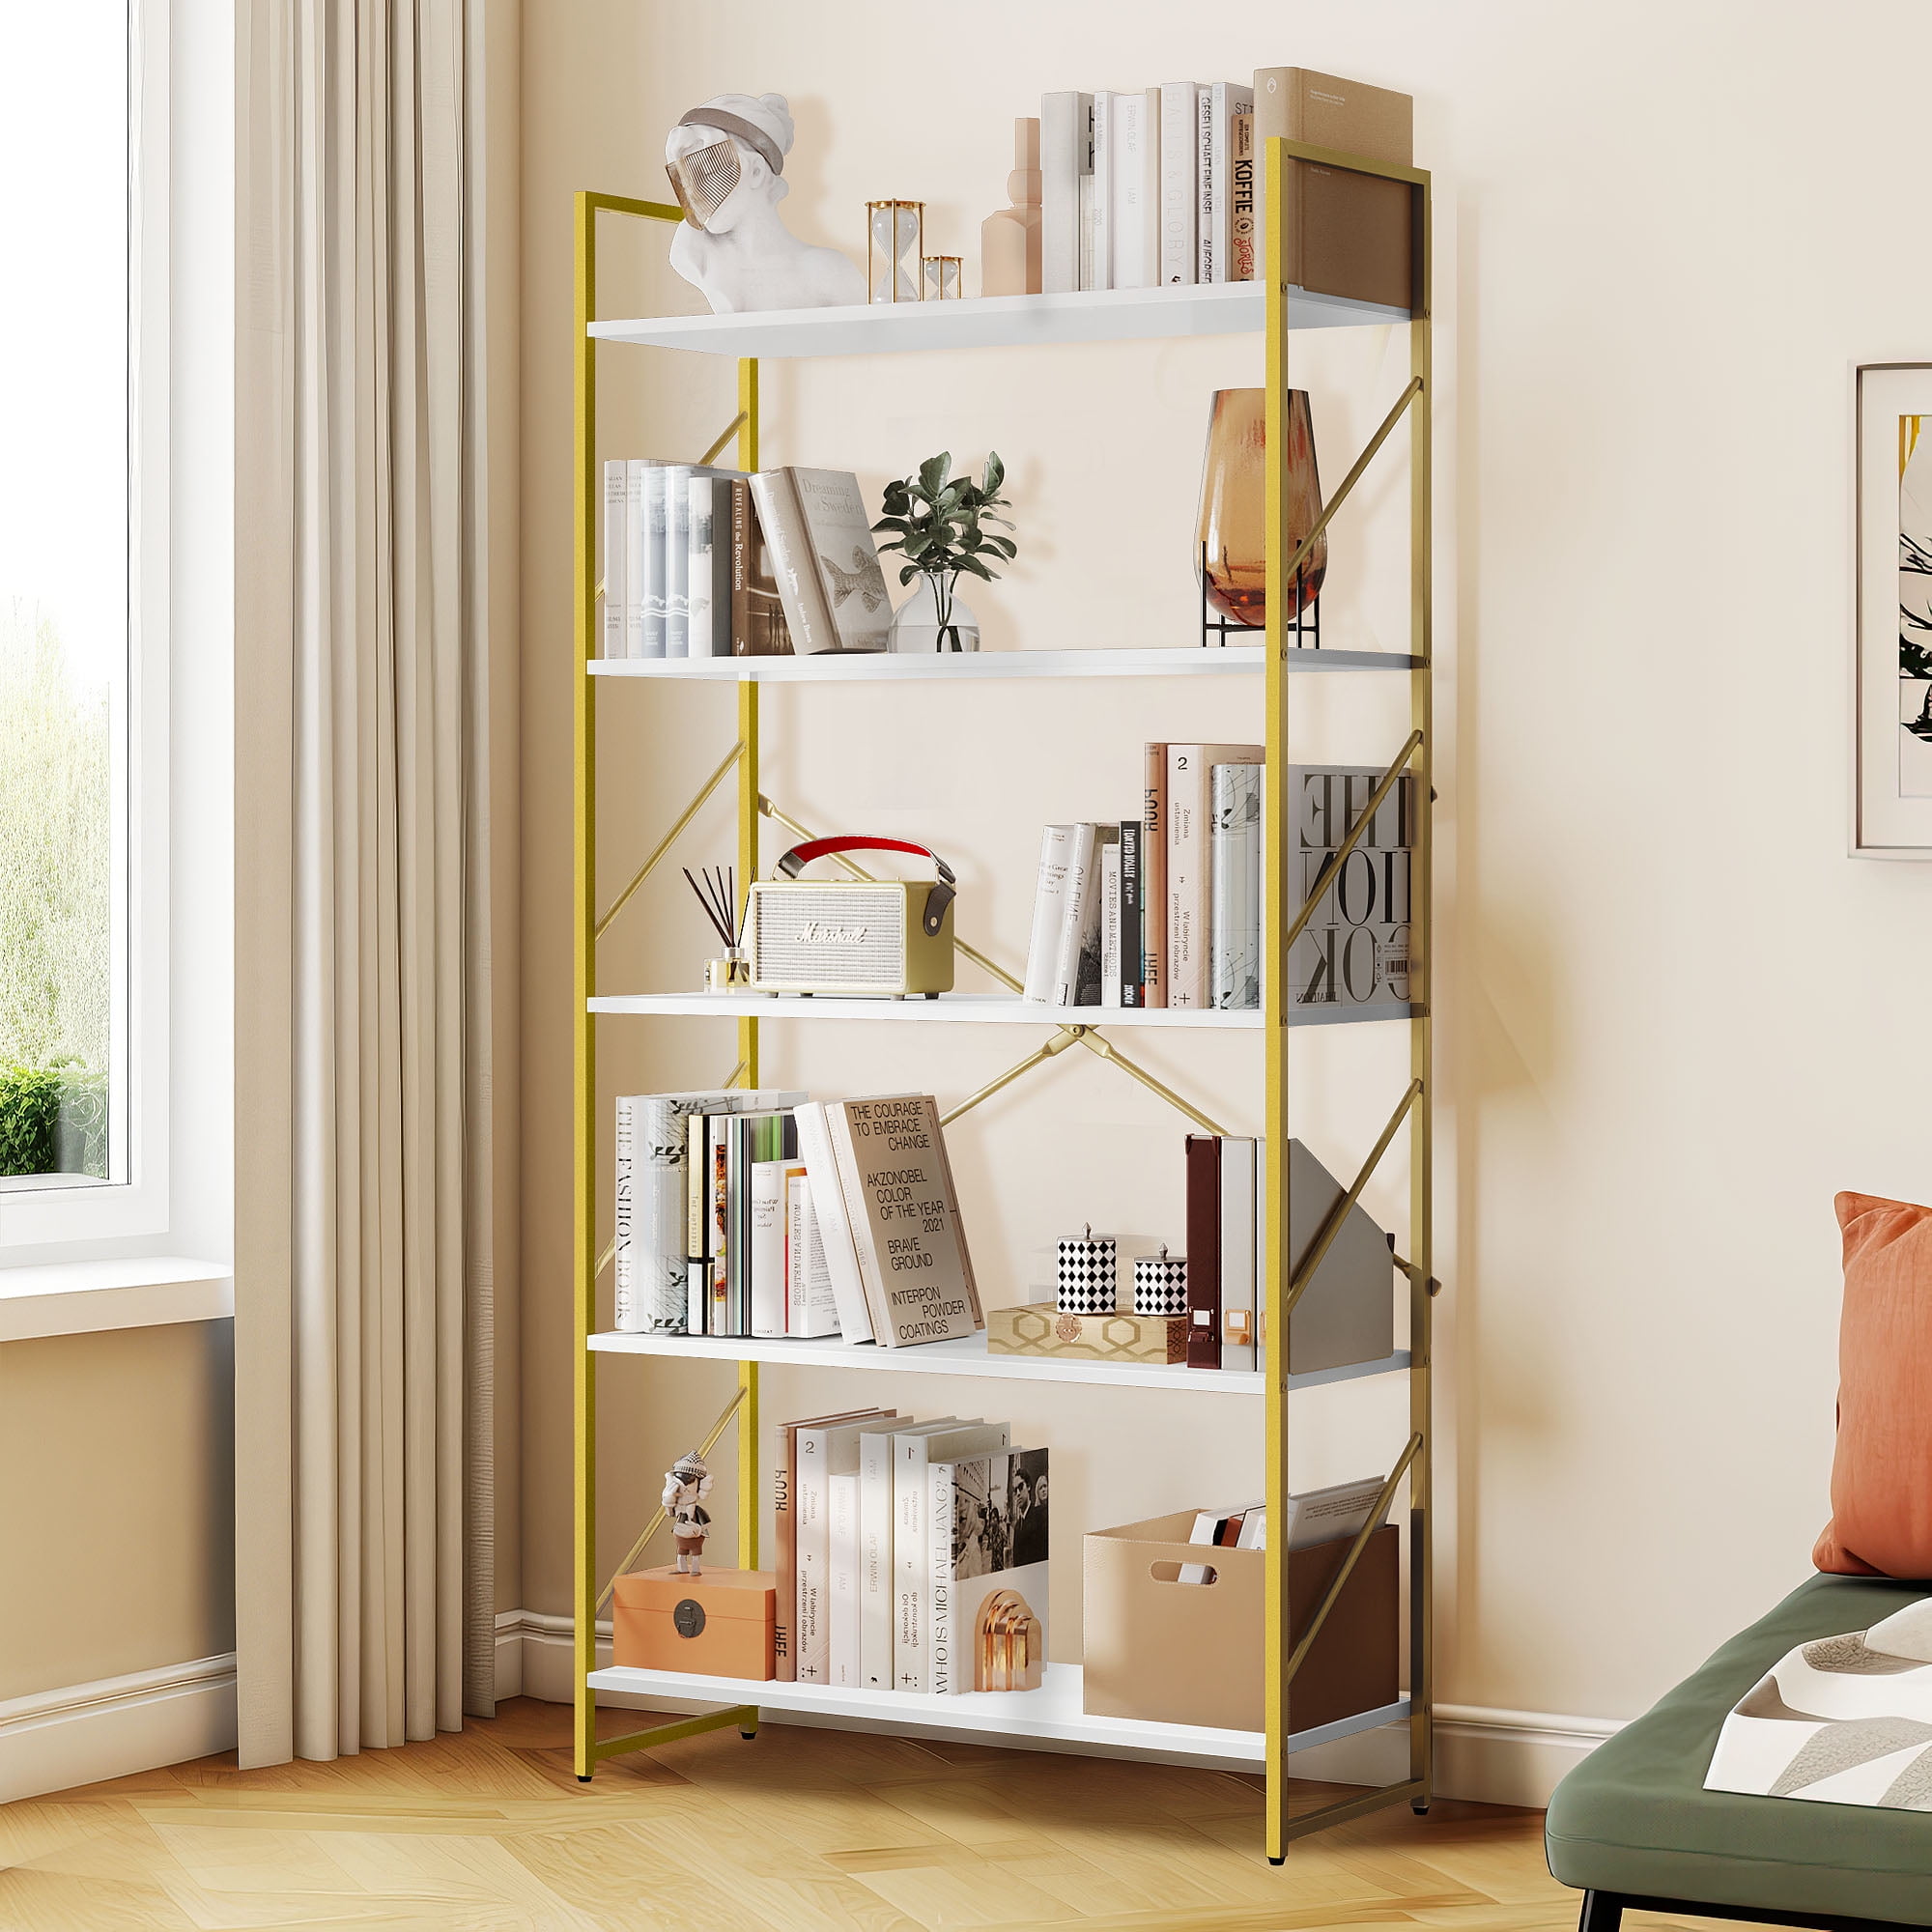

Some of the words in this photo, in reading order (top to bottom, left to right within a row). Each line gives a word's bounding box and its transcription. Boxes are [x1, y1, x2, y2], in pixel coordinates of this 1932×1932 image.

[1235, 159, 1254, 214] KOFFIE
[1166, 189, 1184, 266] GLORY
[1234, 237, 1255, 275] STORIES
[802, 478, 851, 497] Dreaming
[734, 488, 743, 529] REVEALING
[821, 497, 864, 516] Sweden
[734, 543, 744, 591] Revolution
[1178, 756, 1188, 770] 2
[1108, 871, 1117, 909] MOVIES
[1108, 910, 1117, 932] AND
[1172, 893, 1181, 939] przestrzeni
[1182, 911, 1190, 921] W
[795, 920, 867, 944] Marshall
[1180, 922, 1191, 961] labiryncie
[1108, 933, 1117, 978] METHODS
[1173, 944, 1181, 980] obrazów
[851, 1105, 871, 1120] THE
[874, 1101, 923, 1118] COURAGE
[617, 1106, 633, 1151] THE
[855, 1122, 870, 1136] TO
[873, 1119, 922, 1135] EMBRACE
[888, 1135, 930, 1151] CHANGE
[867, 1169, 927, 1187] AKZONOBEL
[617, 1158, 633, 1252] FASHION
[876, 1187, 912, 1204] COLOR
[880, 1206, 894, 1220] OF
[895, 1202, 916, 1218] THE
[916, 1200, 945, 1215] YEAR
[923, 1218, 945, 1233] 2021
[887, 1236, 921, 1254] BRAVE
[891, 1253, 933, 1271] GROUND
[617, 1260, 633, 1321] BOOK
[891, 1287, 941, 1305] INTERPON
[923, 1299, 966, 1319] POWDER
[899, 1320, 949, 1340] COATINGS
[805, 1441, 815, 1454] 2
[935, 1481, 948, 1538] JANG?
[868, 1560, 878, 1593] ERWIN
[935, 1540, 948, 1623] MICHAEL
[800, 1570, 809, 1614] przestrzeni
[810, 1587, 817, 1596] W
[809, 1597, 817, 1636] labiryncie
[935, 1627, 948, 1643] IS
[935, 1648, 948, 1694] WHO
